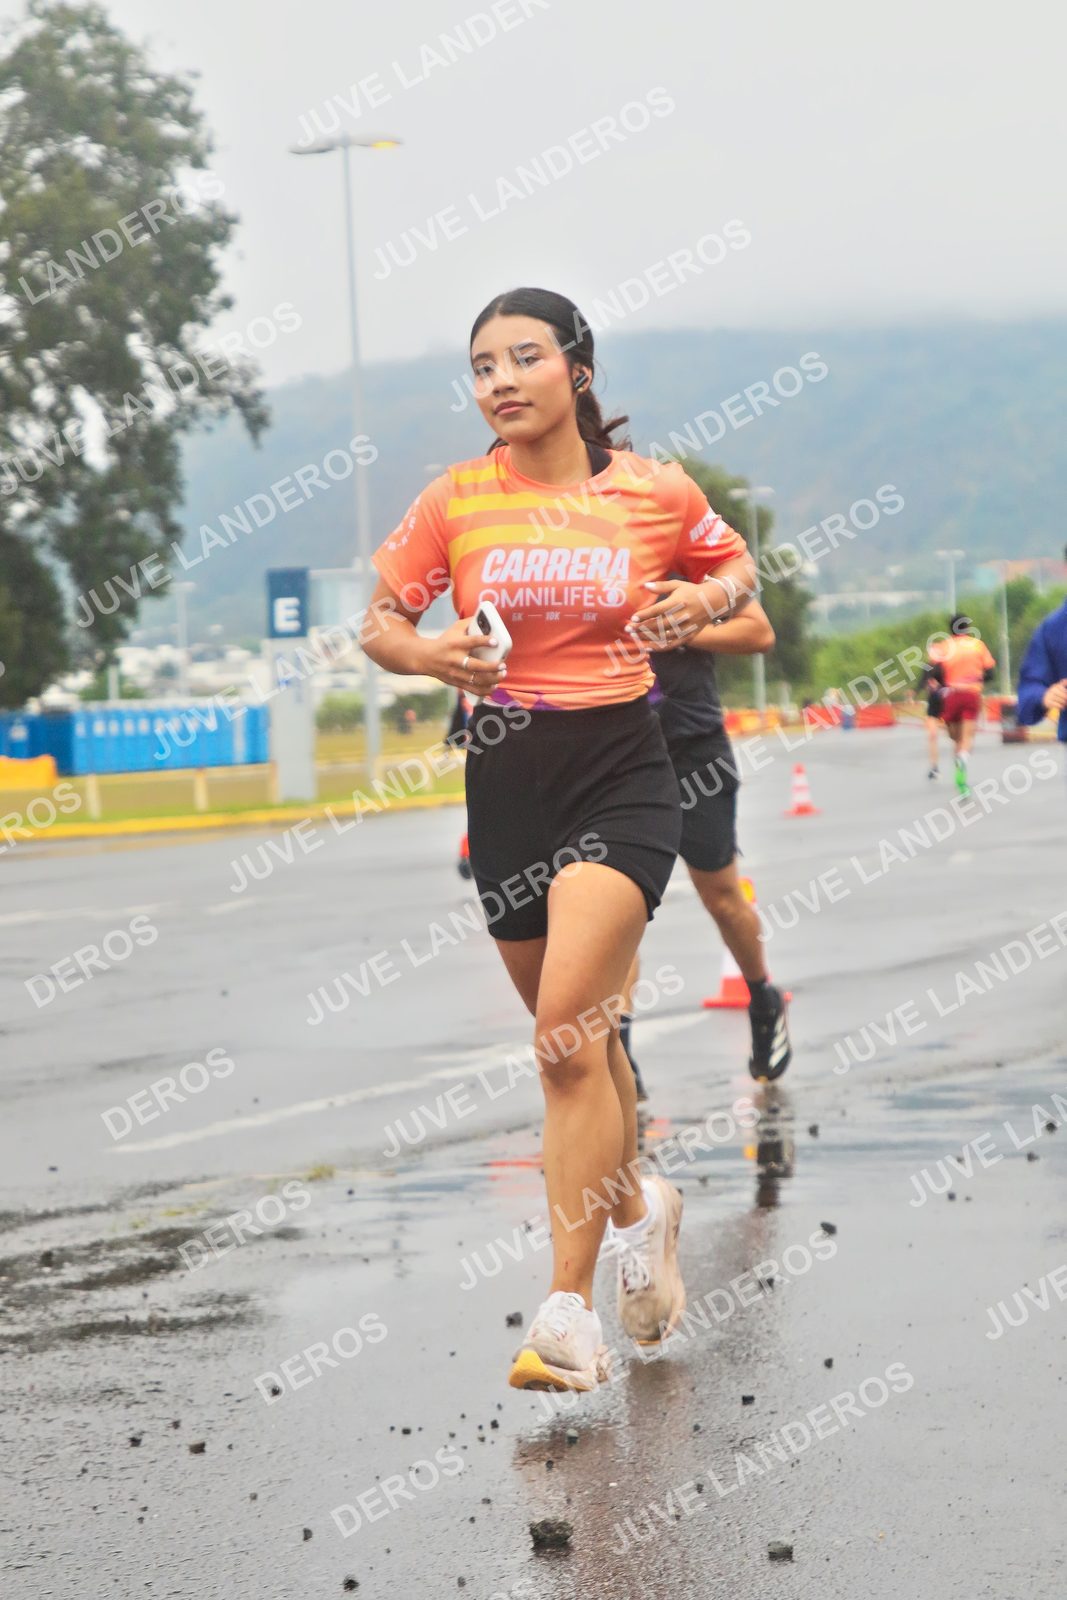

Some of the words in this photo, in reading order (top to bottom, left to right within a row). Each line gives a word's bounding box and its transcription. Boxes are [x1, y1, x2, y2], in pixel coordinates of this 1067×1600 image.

[481, 547, 630, 583] CARRERA
[274, 597, 300, 632] E
[479, 586, 596, 608] OMNILIFE
